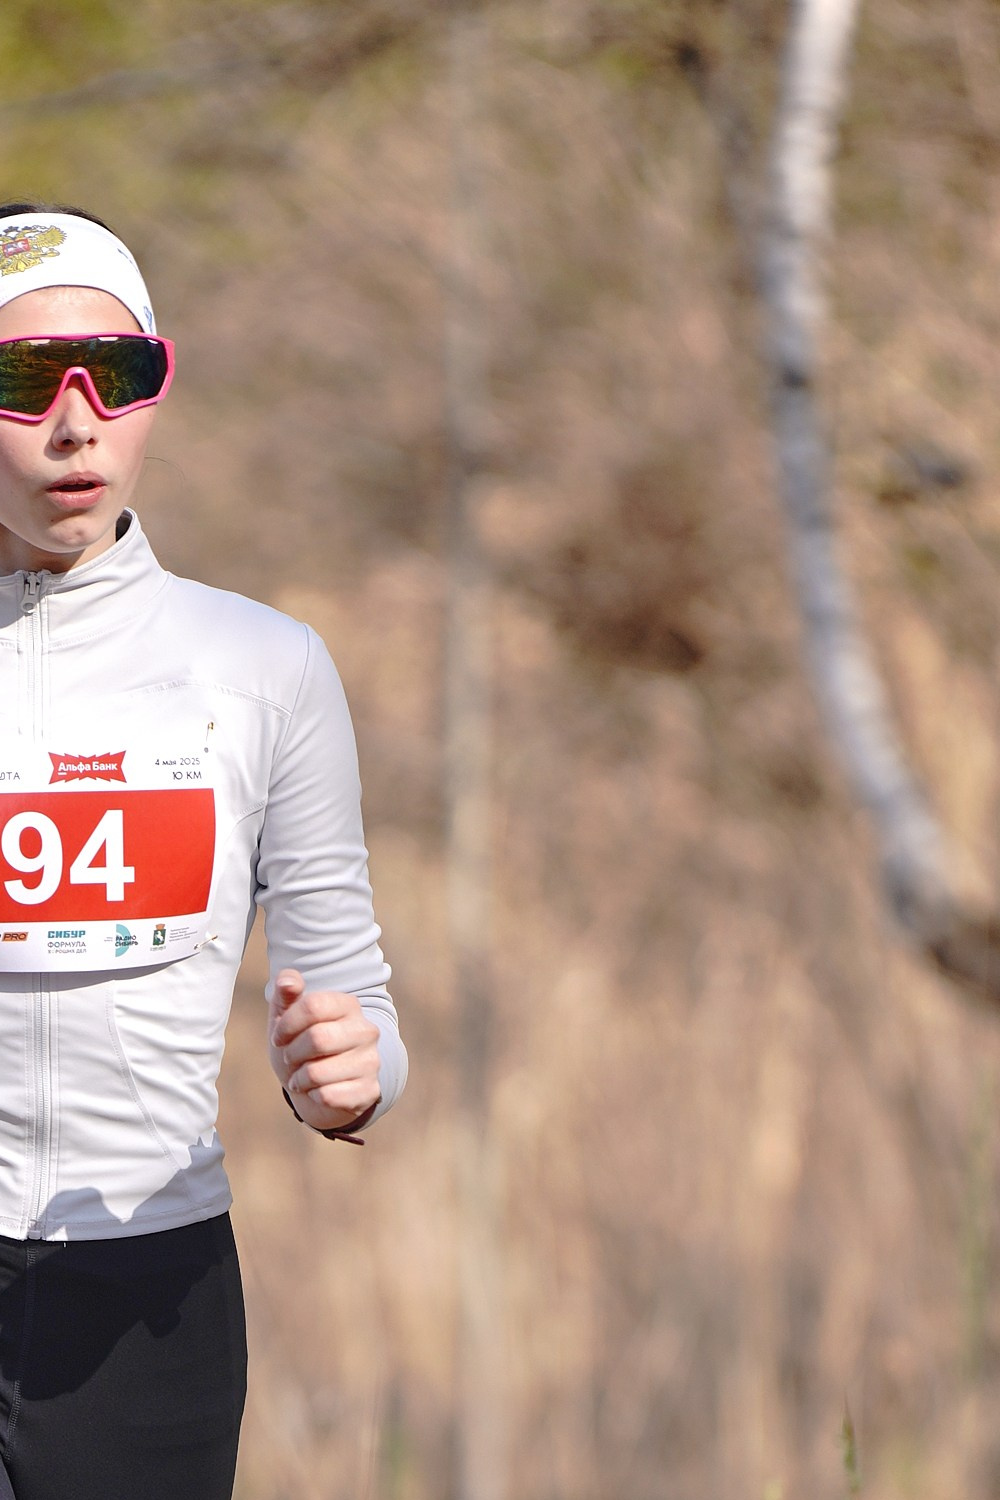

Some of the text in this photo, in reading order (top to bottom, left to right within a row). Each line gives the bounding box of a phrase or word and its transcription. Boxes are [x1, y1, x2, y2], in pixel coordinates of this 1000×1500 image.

[154, 758, 160, 766] 4
[179, 757, 201, 766] 2025
[57, 761, 118, 776] Альфа Банк
[173, 771, 202, 780] 10 КМ
[1, 809, 135, 905] 94
[3, 932, 27, 942] PRO
[47, 930, 86, 939] СИБУР
[114, 940, 139, 948] СИБИРЬ
